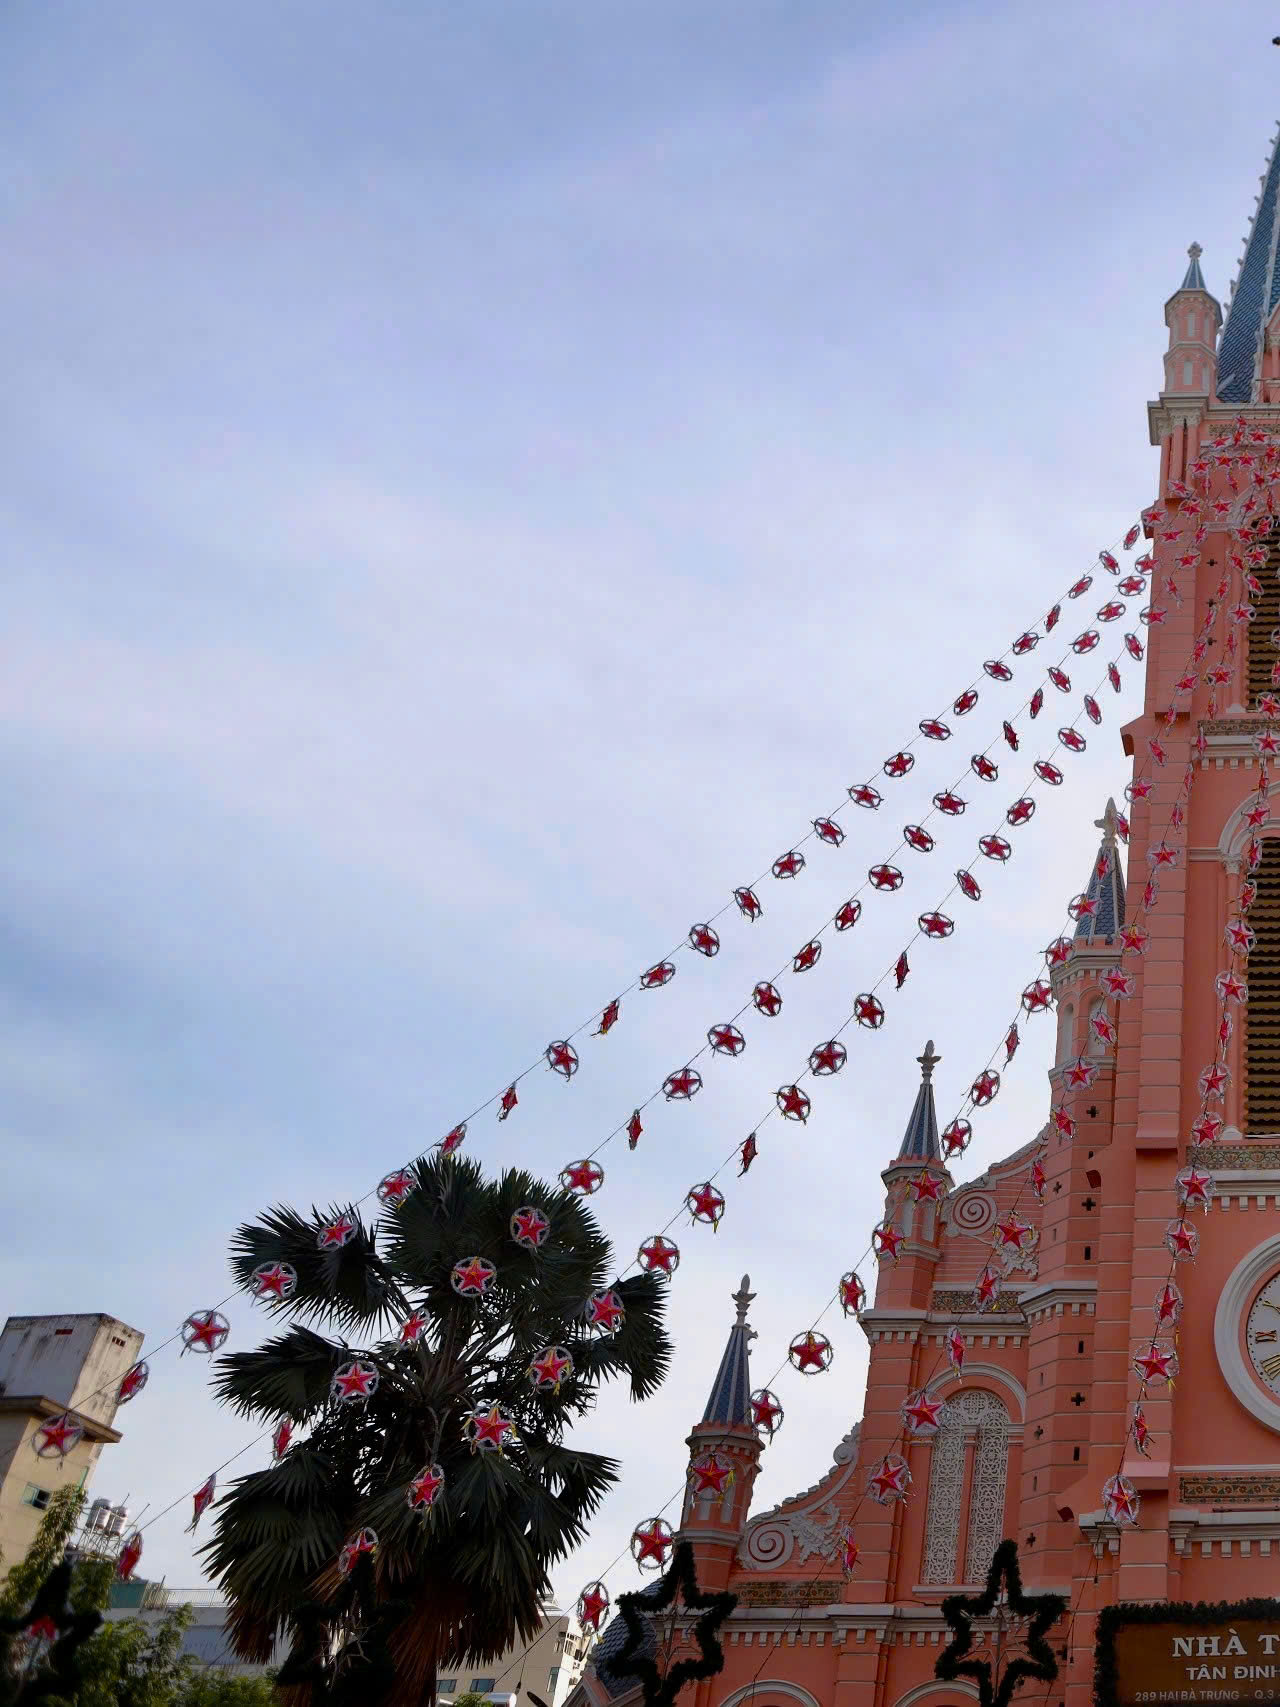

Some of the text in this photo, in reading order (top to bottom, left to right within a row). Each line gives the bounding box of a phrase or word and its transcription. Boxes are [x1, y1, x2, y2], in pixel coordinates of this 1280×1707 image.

[1172, 1628, 1248, 1657] NHÀ
[1185, 1664, 1227, 1681] TÂN
[1135, 1691, 1157, 1702] 289
[1159, 1690, 1179, 1702] HAI
[1180, 1688, 1197, 1701] BÀ
[1199, 1689, 1240, 1701] TRƯNG
[1254, 1689, 1275, 1701] Q.3
